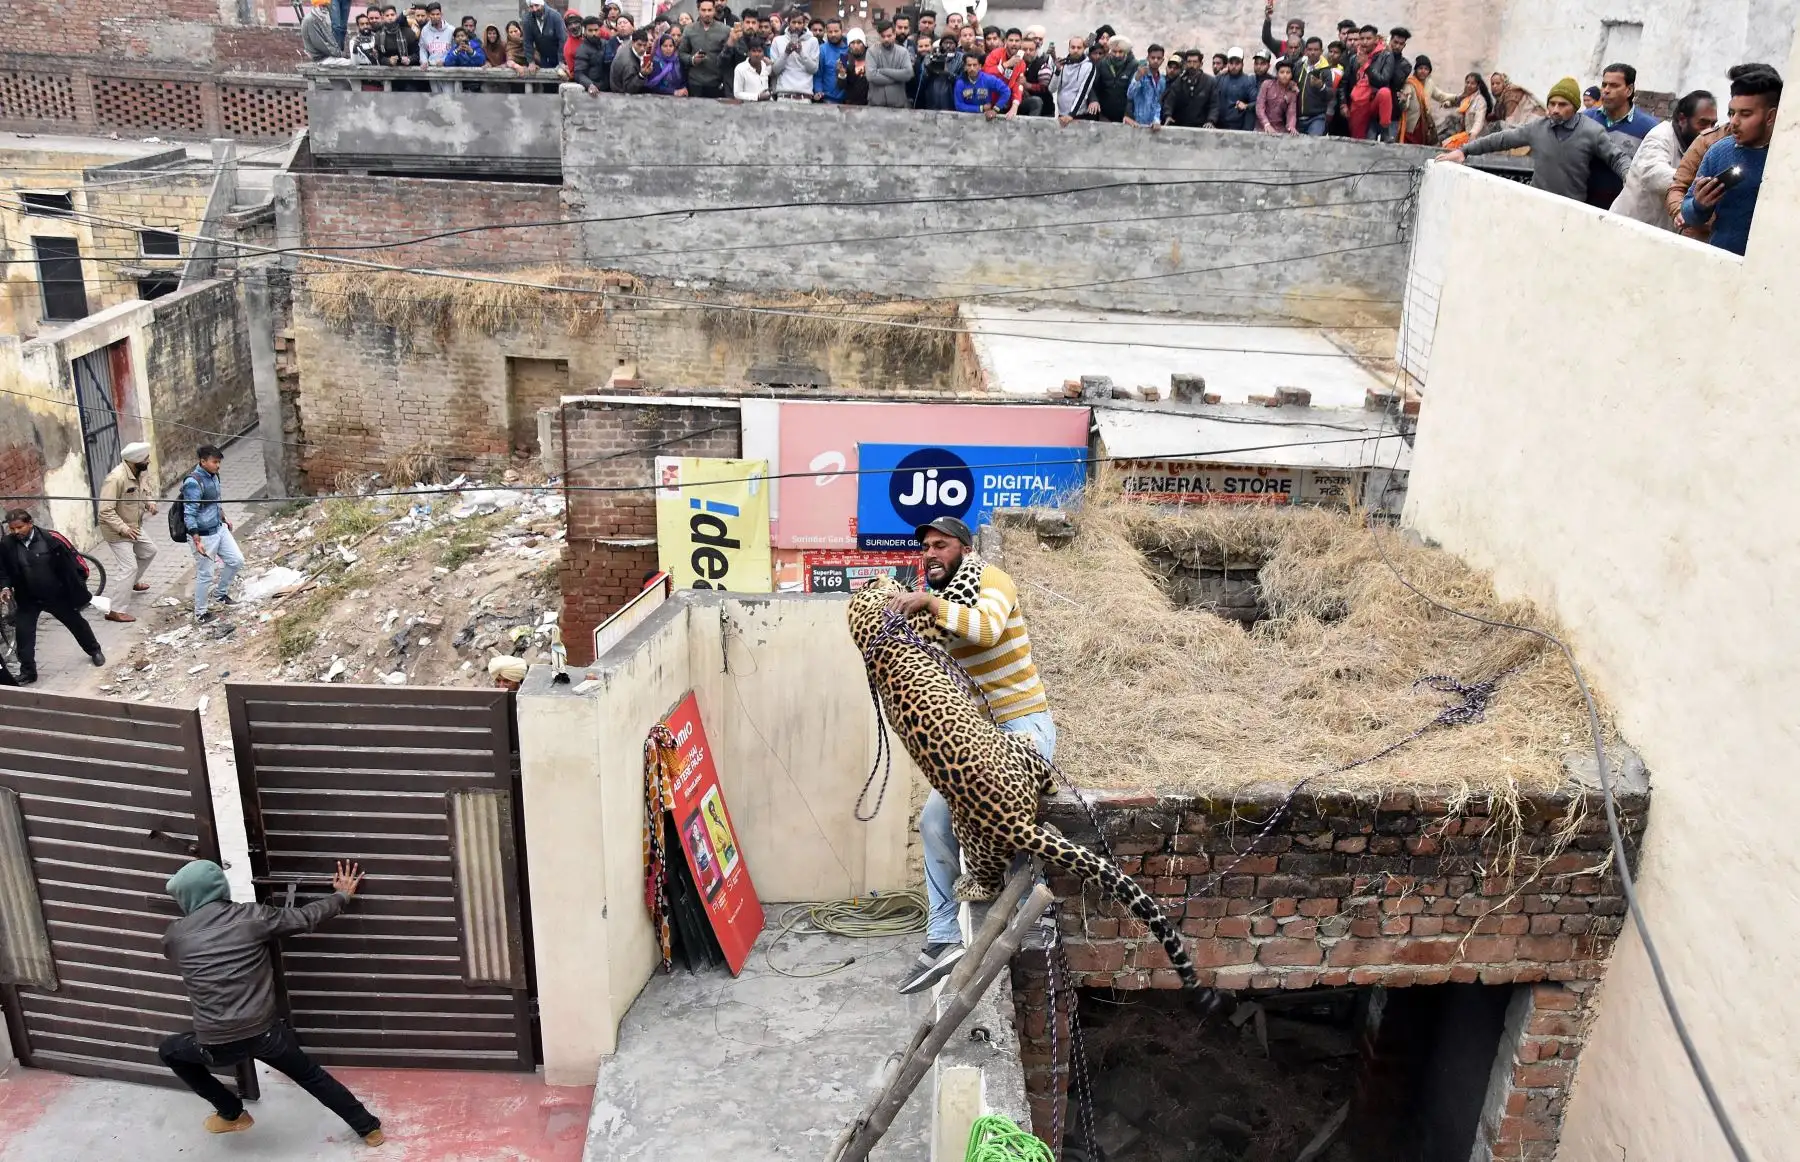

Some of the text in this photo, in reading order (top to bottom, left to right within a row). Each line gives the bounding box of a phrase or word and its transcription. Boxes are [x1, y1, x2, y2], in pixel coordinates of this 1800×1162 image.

[899, 469, 967, 507] Jio
[983, 475, 1056, 491] DIGITAL
[1122, 475, 1292, 494] GENERAL STORE
[983, 492, 1021, 507] LIFE
[792, 534, 827, 544] Surinder
[828, 535, 844, 544] Gen
[865, 539, 921, 547] SURINDER GE
[813, 569, 842, 577] SuperPlan
[813, 576, 843, 587] ₹169
[680, 767, 693, 784] TERE
